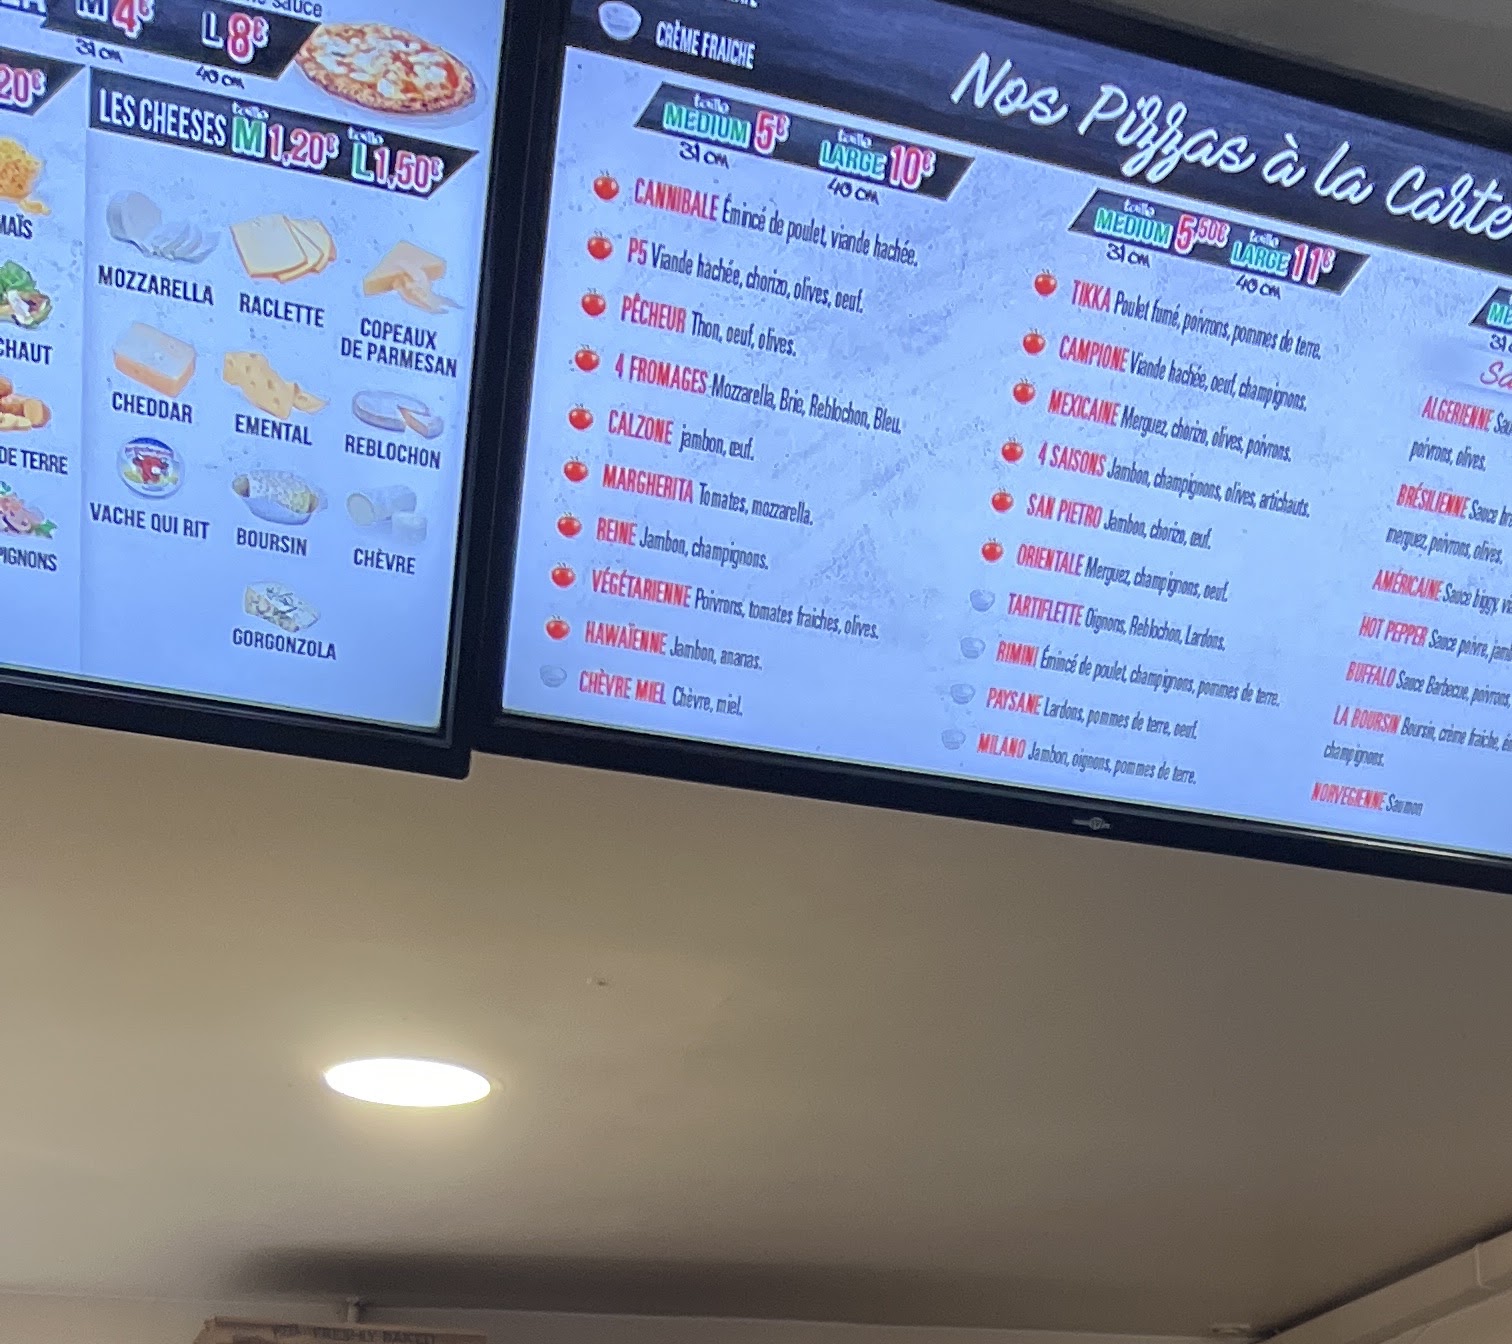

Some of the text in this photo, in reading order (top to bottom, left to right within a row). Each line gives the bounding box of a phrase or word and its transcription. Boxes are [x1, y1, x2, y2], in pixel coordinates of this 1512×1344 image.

[202, 12, 223, 48] L
[655, 19, 755, 71] CRÈME FRAICHE
[100, 89, 135, 128] LES
[139, 98, 227, 147] CHEESES
[232, 116, 267, 153] M
[352, 142, 373, 182] L
[662, 104, 752, 149] MEDIUM
[819, 139, 887, 179] LARGE
[951, 51, 1070, 125] Nos
[1077, 82, 1255, 182] Pizzas
[1262, 134, 1308, 187] à
[1314, 141, 1375, 205] la
[634, 178, 719, 223] CANNIBALE
[722, 192, 767, 232] Émincé
[769, 208, 784, 236] de
[830, 227, 870, 257] viande
[872, 231, 918, 268] hachée.
[1094, 207, 1172, 245] MEDIUM
[1230, 241, 1290, 275] LARGE
[97, 265, 215, 307] MOZZARELLA
[627, 237, 864, 314] P5 Viande hachée, chorizo, olives, oeuf.
[239, 293, 325, 328] RACLETTE
[1071, 280, 1111, 314] TIKKA
[360, 317, 438, 350] COPEAUX
[620, 293, 686, 334] PÊCHEUR
[691, 309, 722, 344] Thon,
[758, 323, 796, 358] olives.
[340, 337, 457, 380] DE PARMESAN
[1059, 336, 1129, 373] CAMPIONE
[112, 392, 194, 425] CHEDDAR
[615, 353, 902, 435] 4 FROMAGES Mozzarella, Brie, Reblochon, Bleu.
[1048, 390, 1120, 428] MEXICAINE
[235, 415, 313, 447] EMENTAL
[608, 409, 674, 446] CALZONE
[22, 448, 69, 476] TERRE
[345, 434, 441, 470] REBLOCHON
[1049, 445, 1107, 478] SAISONS
[602, 463, 813, 527] MARGHERITA Tomates, mozzarella.
[1027, 494, 1103, 529] SAN PIETRO
[90, 503, 211, 541] VACHE QUI RIT
[596, 517, 638, 546] REINE
[236, 527, 308, 557] BOURSIN
[353, 544, 416, 575] CHÈVRE
[1016, 544, 1085, 577] ORIENTALE
[592, 567, 692, 608] VÉGÉTARIENNE
[1008, 592, 1085, 628] TARTIFLETTE
[232, 628, 337, 662] GORGONZOLA
[584, 619, 668, 655] HAWAÏENNE
[579, 668, 666, 704] CHÈVRE MIEL
[1345, 661, 1397, 688] BUFFALO
[986, 688, 1044, 715] PAYSANE
